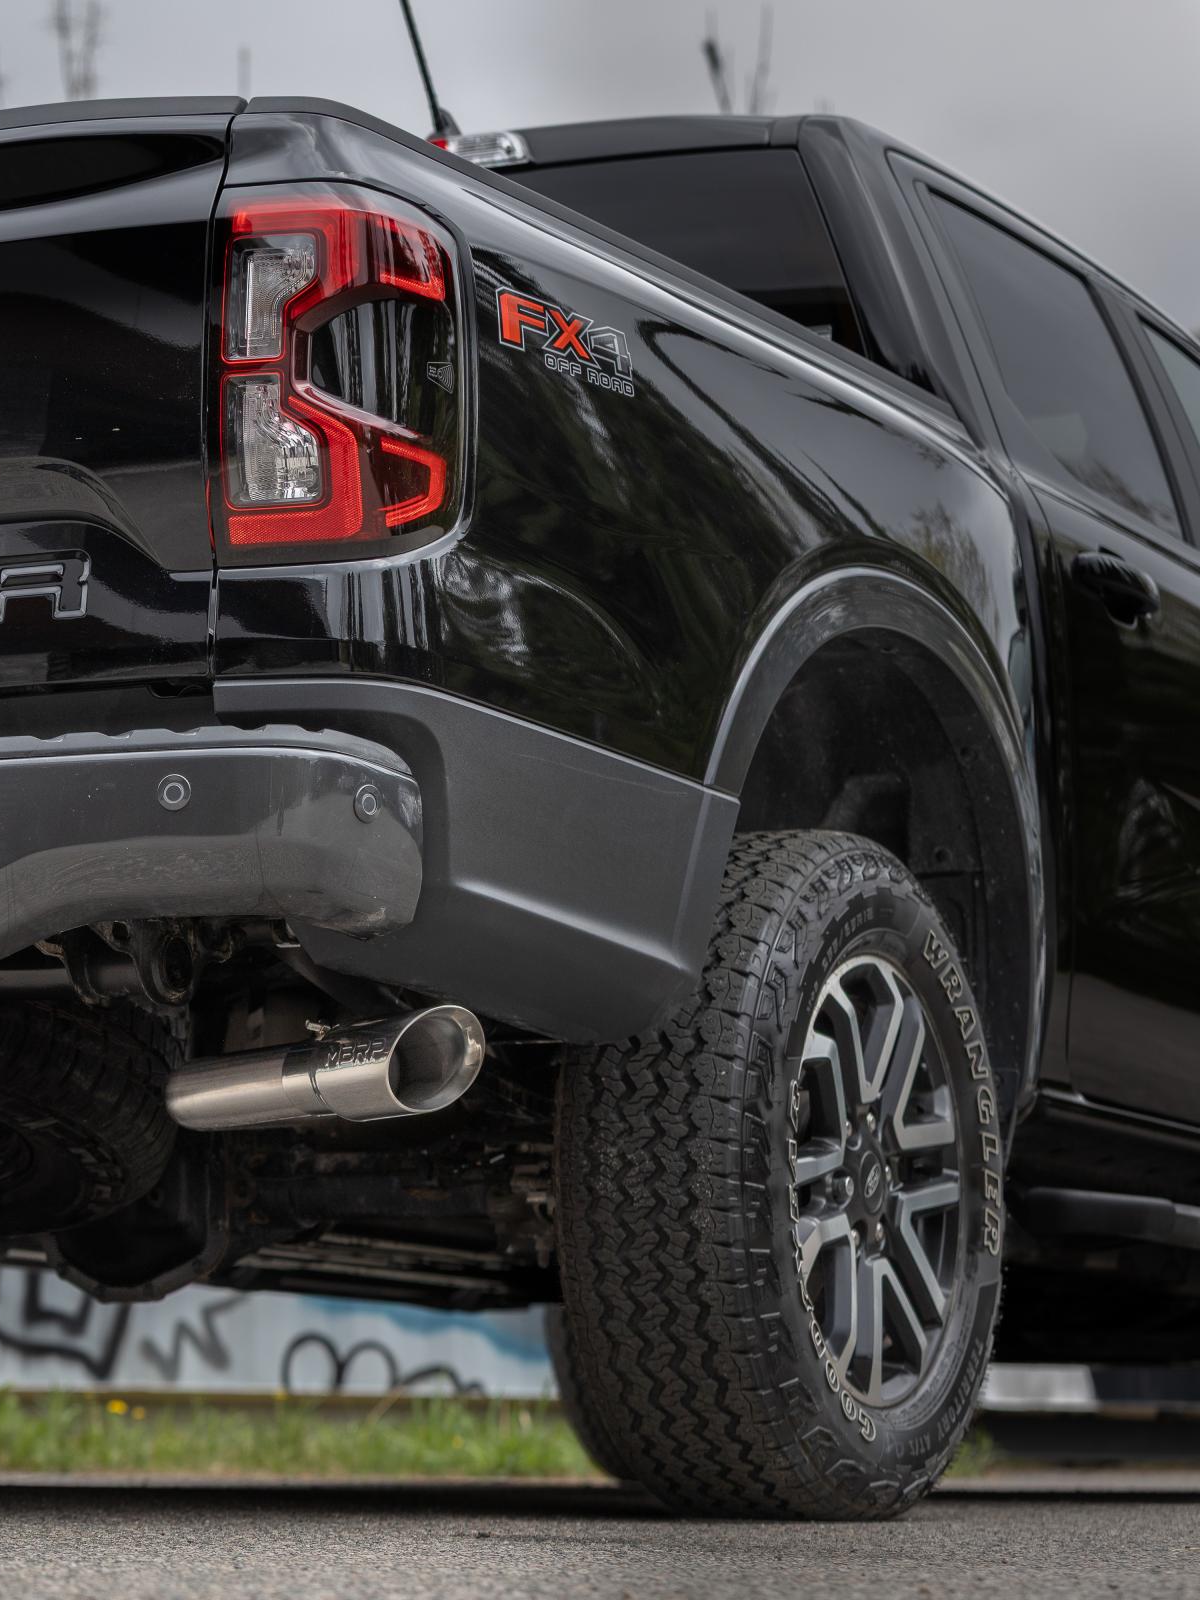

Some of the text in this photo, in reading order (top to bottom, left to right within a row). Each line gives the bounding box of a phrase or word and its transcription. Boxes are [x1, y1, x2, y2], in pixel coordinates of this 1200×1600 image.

[495, 286, 633, 381] FX4
[544, 353, 635, 398] OFF ROAD
[923, 929, 1001, 1256] WRANGLER
